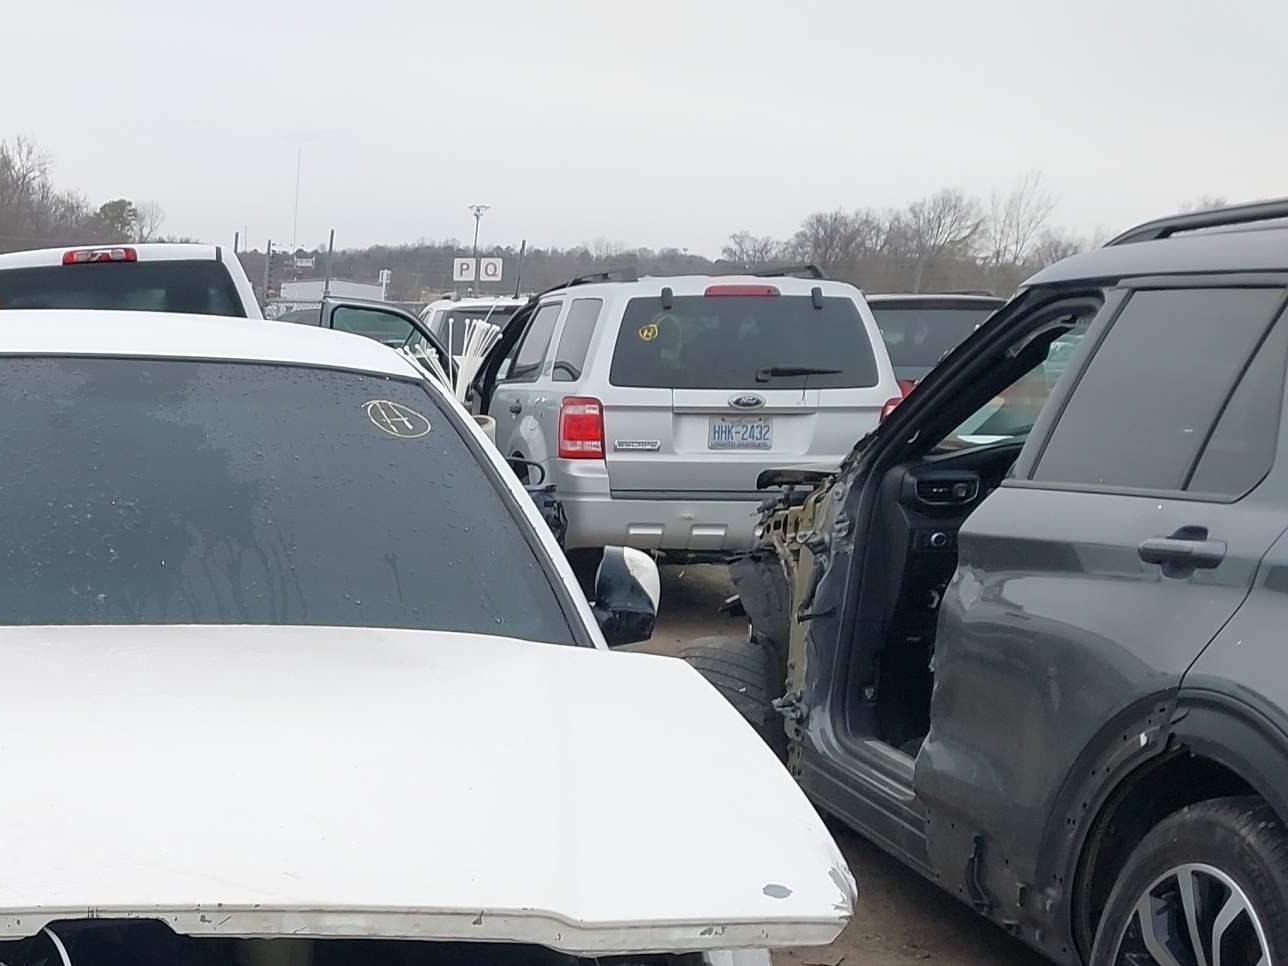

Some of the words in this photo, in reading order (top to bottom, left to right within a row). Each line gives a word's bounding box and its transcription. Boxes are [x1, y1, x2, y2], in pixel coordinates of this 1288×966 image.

[460, 262, 470, 277] P
[484, 262, 498, 277] Q
[713, 424, 770, 441] HHK-2432
